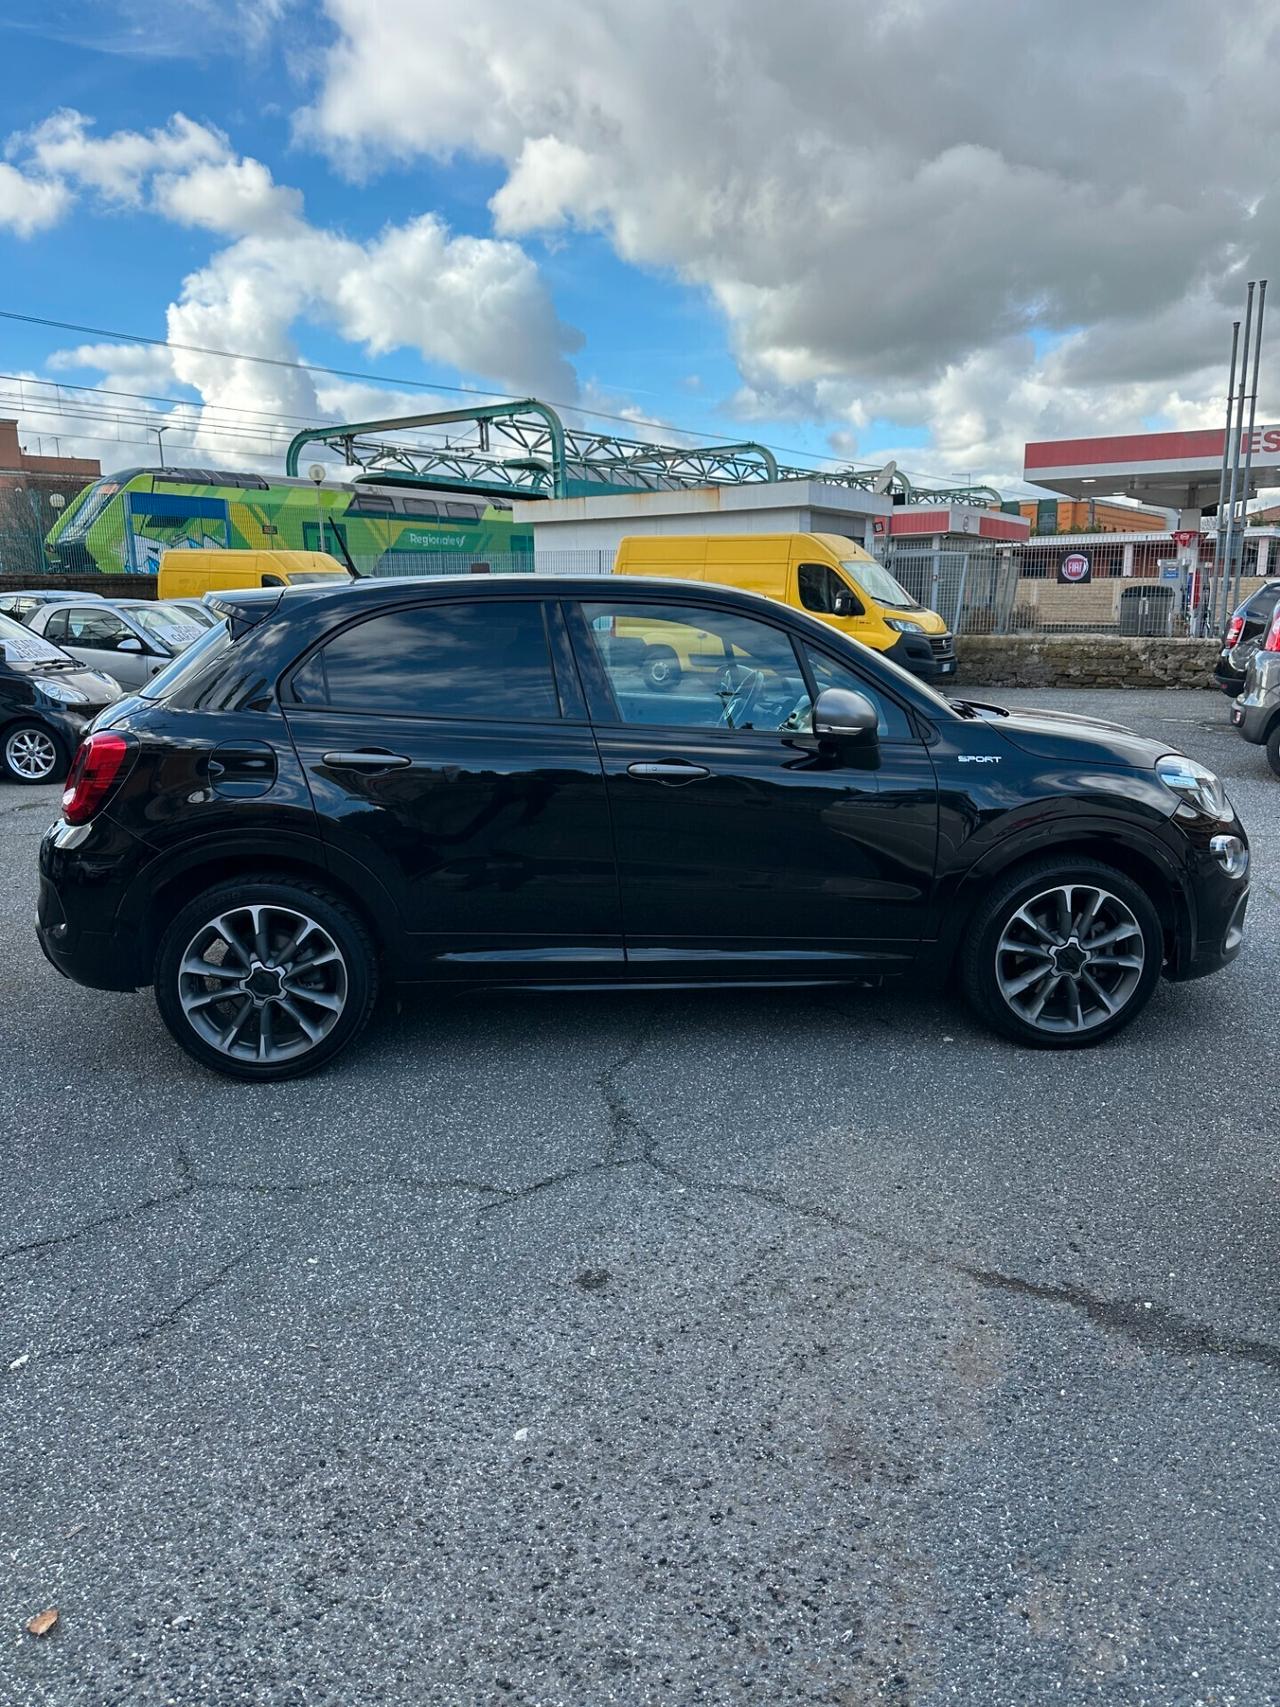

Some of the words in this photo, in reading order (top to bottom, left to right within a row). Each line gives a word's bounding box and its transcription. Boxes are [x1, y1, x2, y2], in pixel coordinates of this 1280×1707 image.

[409, 533, 456, 547] Regionale
[1068, 561, 1084, 574] FIAT
[957, 755, 1003, 763] SPORT
